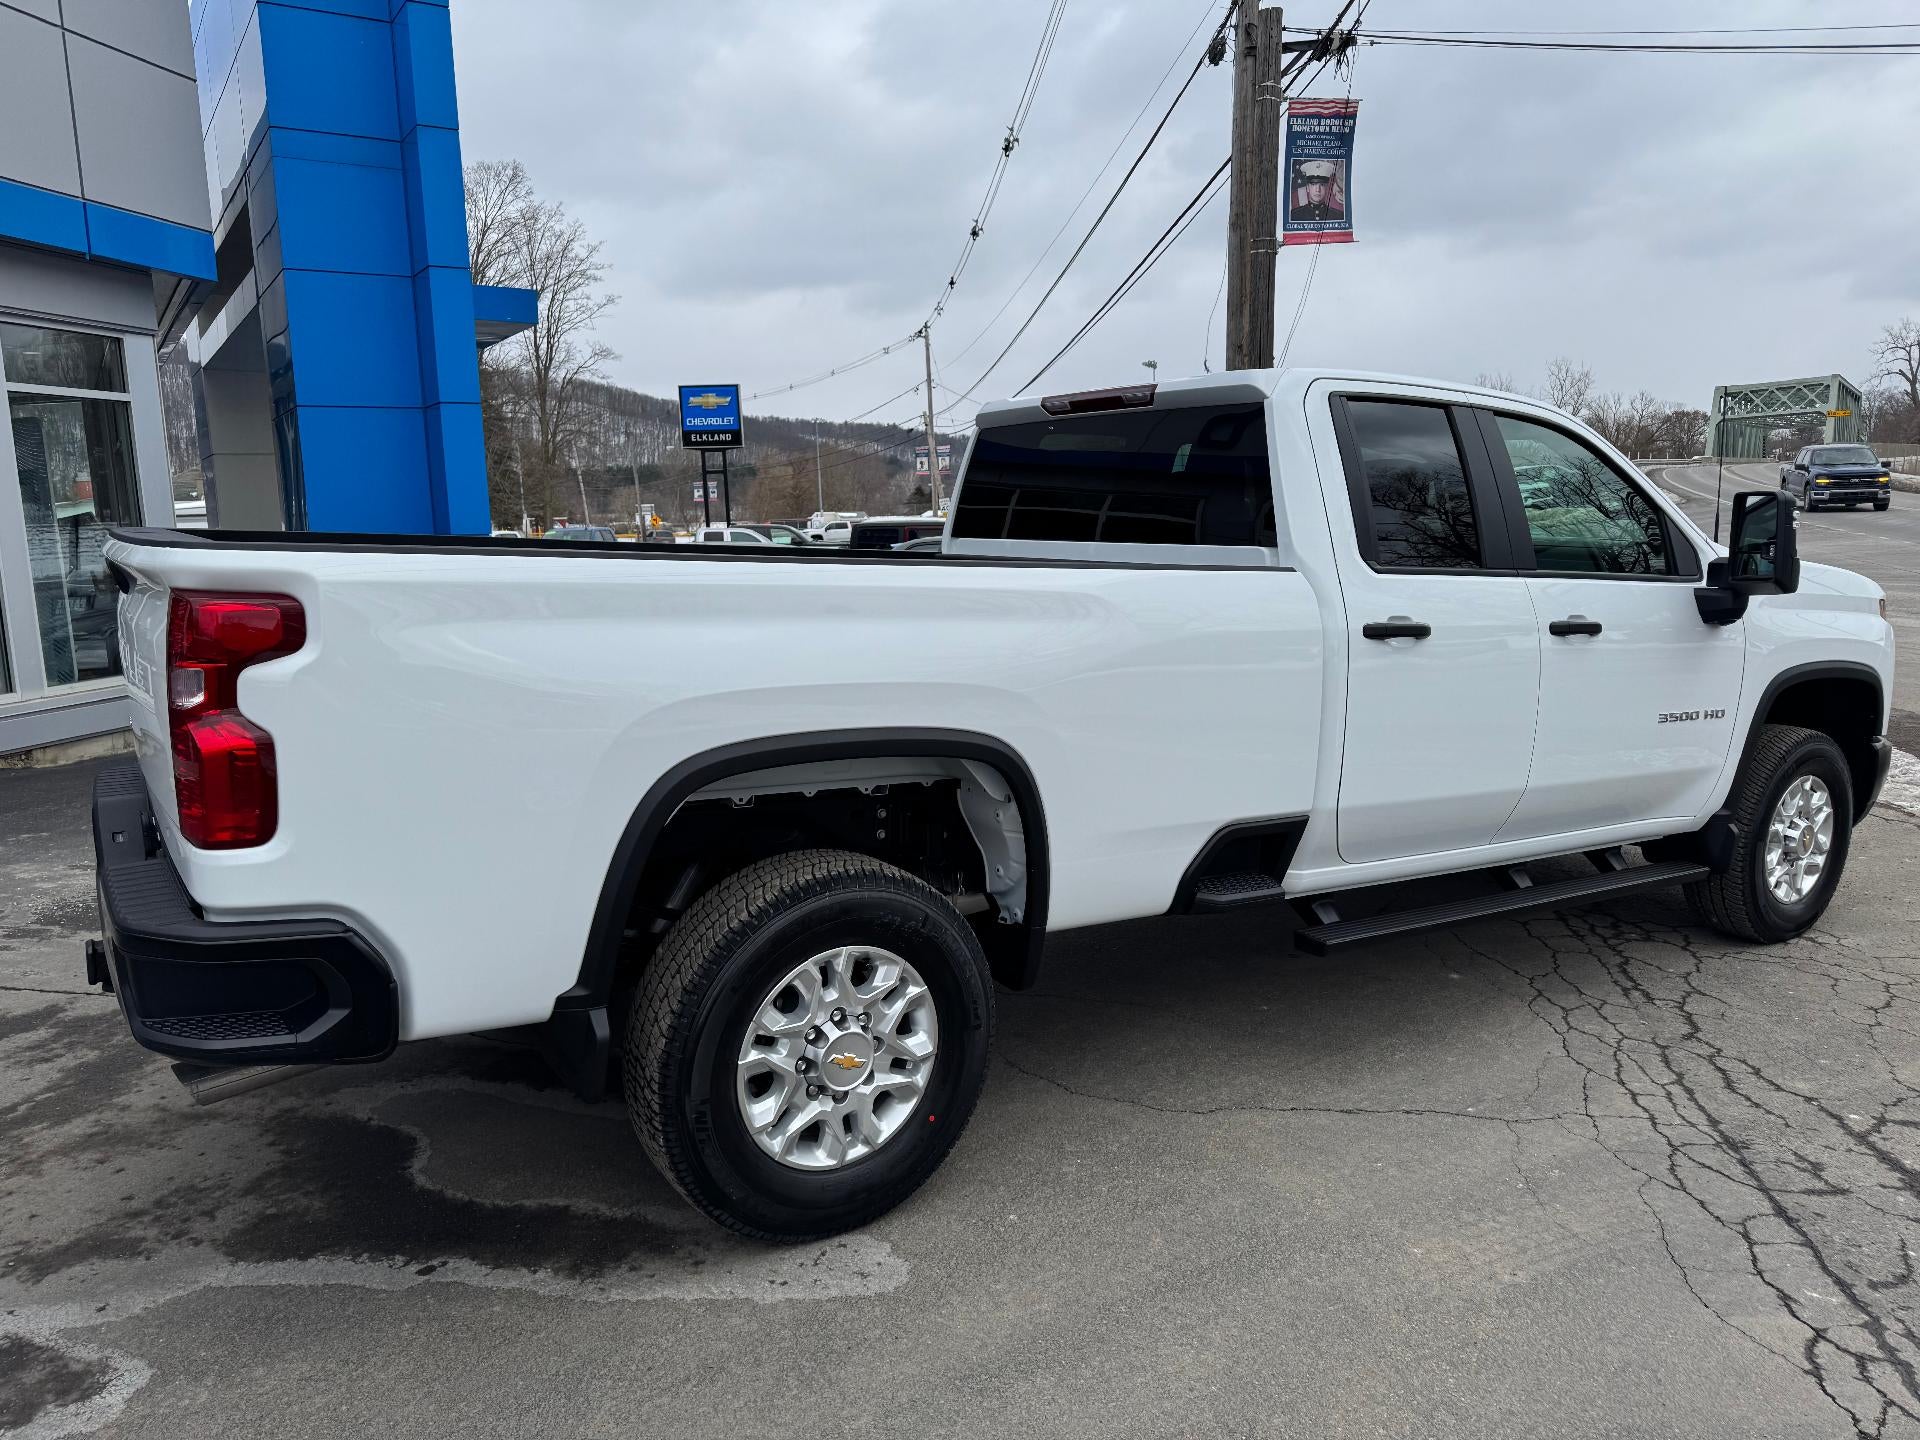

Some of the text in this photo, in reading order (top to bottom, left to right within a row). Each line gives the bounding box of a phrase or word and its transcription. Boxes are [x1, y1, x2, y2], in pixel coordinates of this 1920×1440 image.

[1289, 117, 1319, 125] ELKLAND
[686, 416, 735, 426] CHEVROLET
[691, 433, 732, 442] ELKLAND
[1657, 708, 1726, 724] 3500 HD
